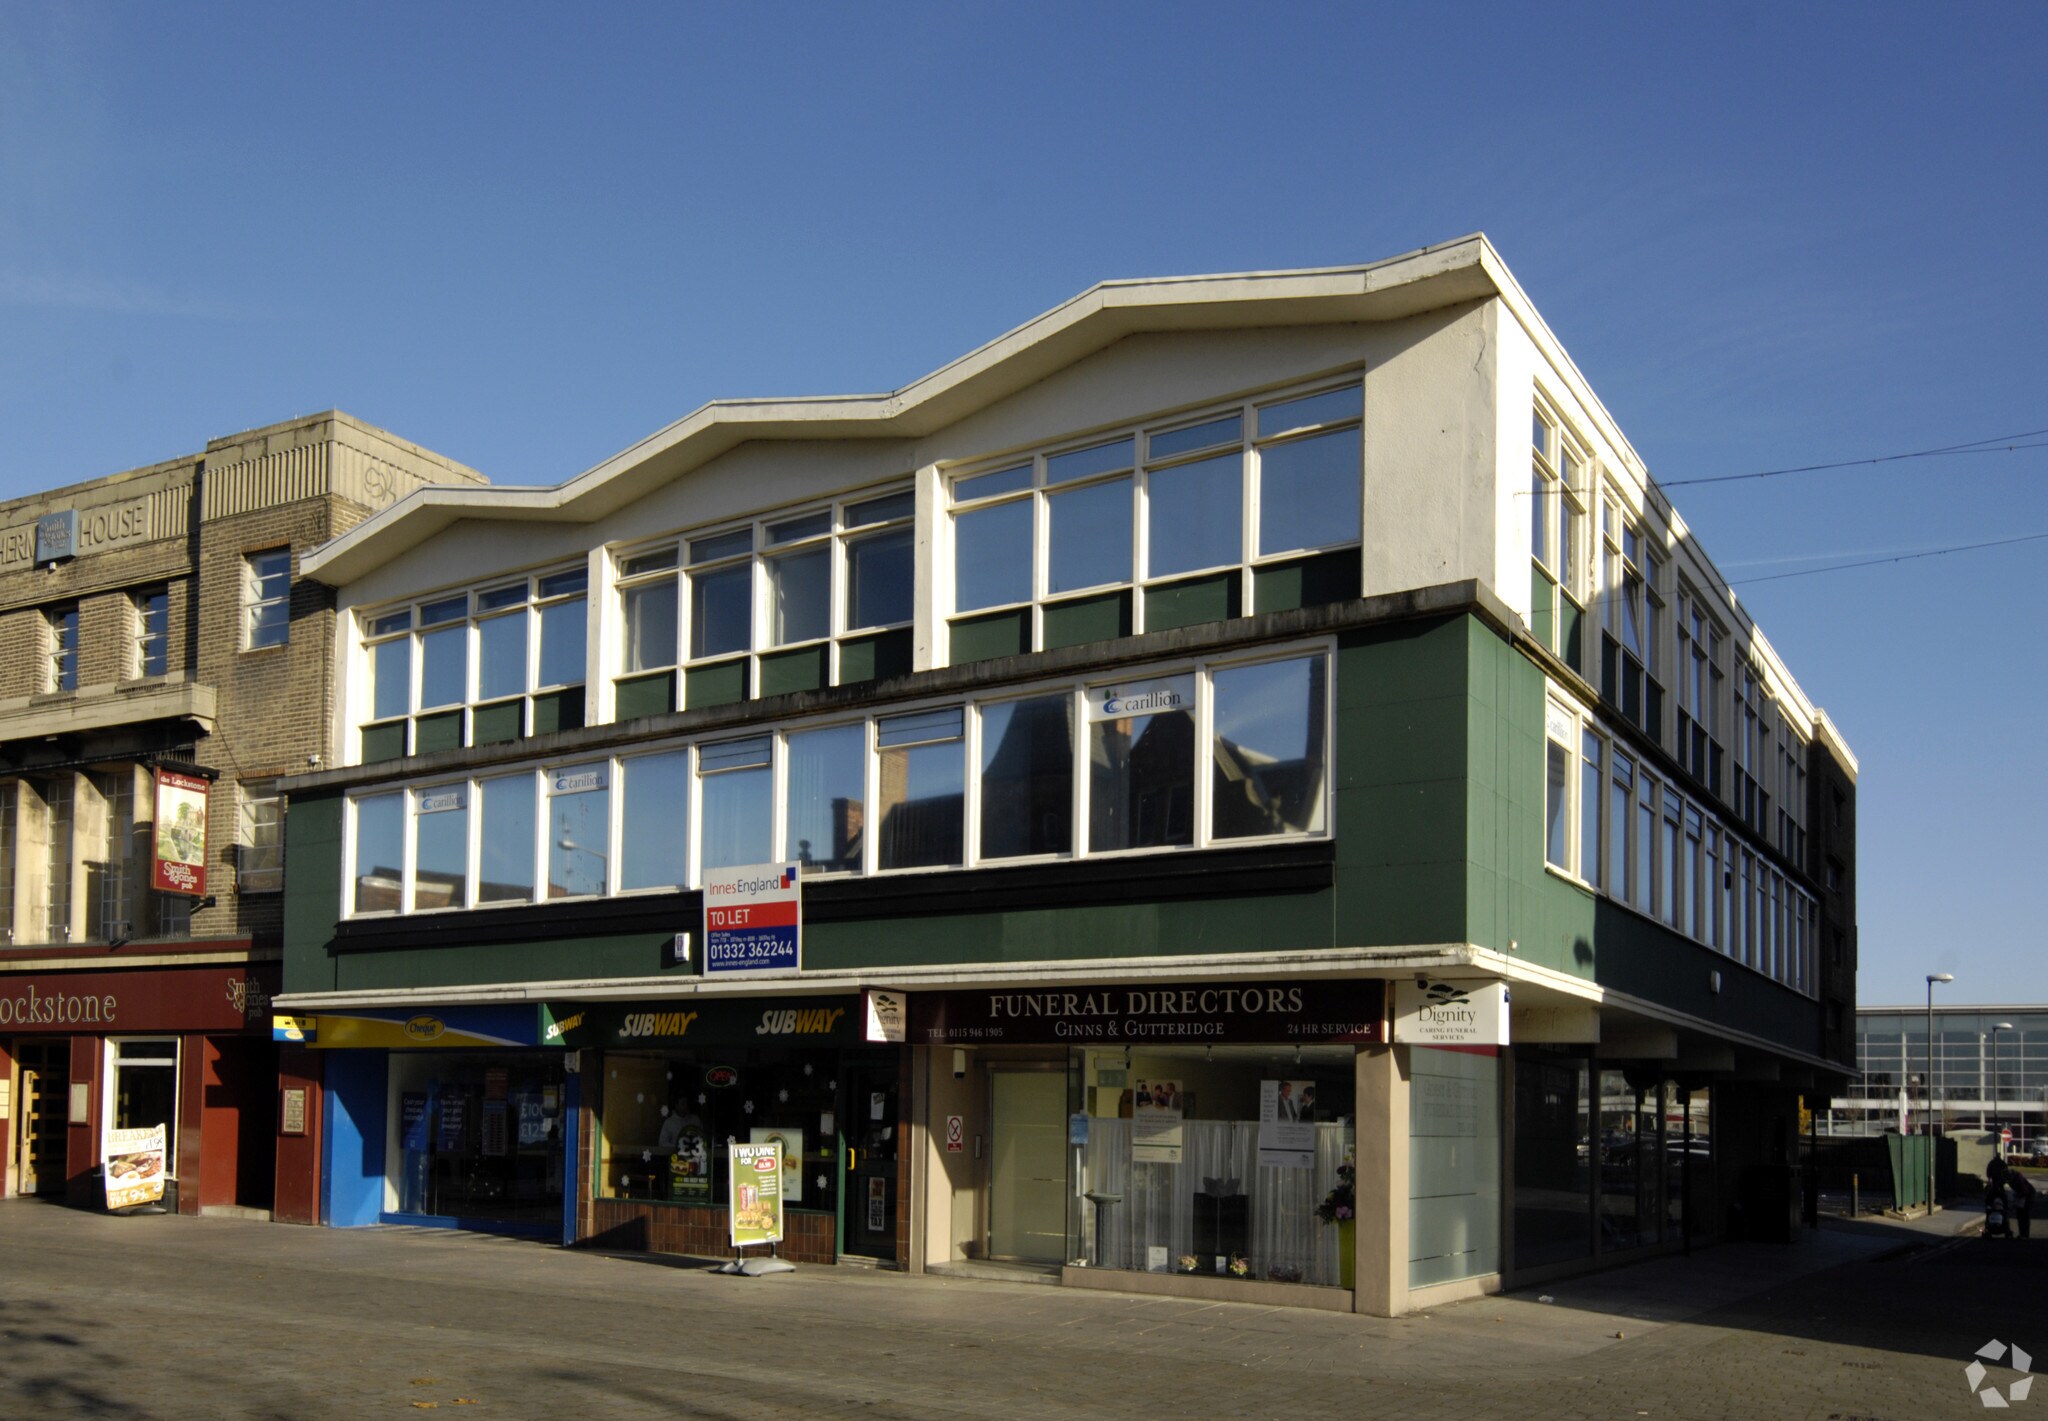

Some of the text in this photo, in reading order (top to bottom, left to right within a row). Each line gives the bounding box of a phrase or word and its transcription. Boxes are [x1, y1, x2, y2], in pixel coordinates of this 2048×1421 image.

[79, 507, 143, 548] HOUSE
[1125, 692, 1181, 711] carillion
[160, 776, 205, 790] the Lockstone
[569, 773, 603, 790] carillion
[433, 794, 463, 809] carillion
[163, 861, 191, 877] Smith
[181, 881, 193, 890] pub
[710, 909, 750, 926] TO LET
[710, 940, 793, 960] 01332 362244
[712, 958, 770, 968] www.innes-england.com
[226, 977, 261, 1001] Smith
[0, 985, 117, 1024] ockstone
[989, 987, 1304, 1018] FUNERAL DIRECTORS
[248, 1006, 264, 1021] pub
[755, 1008, 845, 1036] SUBWAY
[1418, 1004, 1477, 1026] Dignity
[409, 1022, 436, 1036] Cheque
[545, 1011, 586, 1040] SUBWAY
[619, 1011, 698, 1037] SUBWAY
[949, 1028, 967, 1038] 0115
[969, 1028, 983, 1037] 946
[985, 1027, 1003, 1037] 1905
[1055, 1019, 1225, 1036] GINNS & GUTTERIDGE
[1287, 1023, 1372, 1035] 24 HR SERVICE
[677, 1136, 703, 1156] £3
[755, 1146, 775, 1157] DINE
[741, 1157, 751, 1165] FOR
